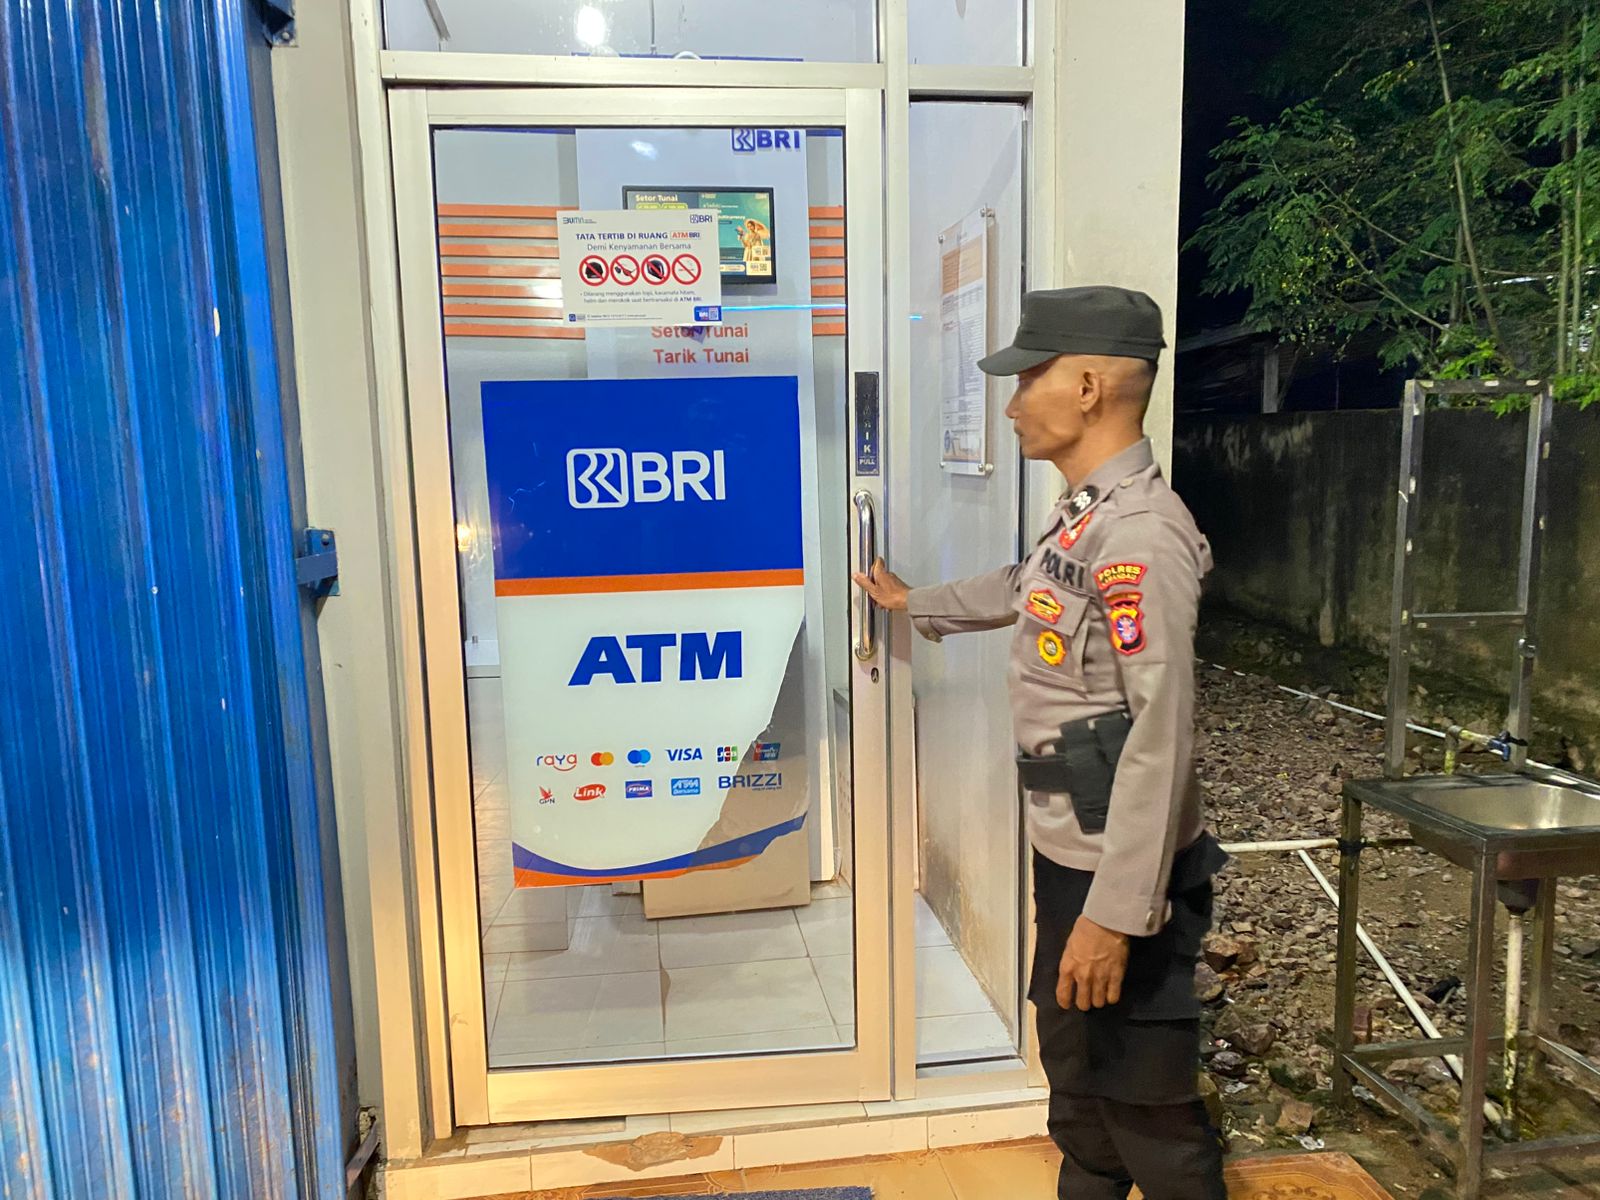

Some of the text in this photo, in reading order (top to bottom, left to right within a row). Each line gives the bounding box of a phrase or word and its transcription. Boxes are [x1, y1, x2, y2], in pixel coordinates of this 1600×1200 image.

[757, 130, 800, 149] BRI
[635, 194, 678, 202] Setor Tunai
[698, 215, 713, 223] BRI
[587, 243, 607, 251] Demi
[609, 243, 658, 251] Kenyamanan
[651, 323, 749, 338] Setor Tunai
[653, 348, 749, 364] Tarik Tunai
[632, 449, 726, 503] BRI
[1097, 564, 1142, 582] POLRES
[568, 631, 742, 686] ATM
[536, 753, 578, 767] raya
[664, 748, 703, 761] VISA
[718, 773, 782, 789] BRIZZI
[575, 785, 604, 798] Link
